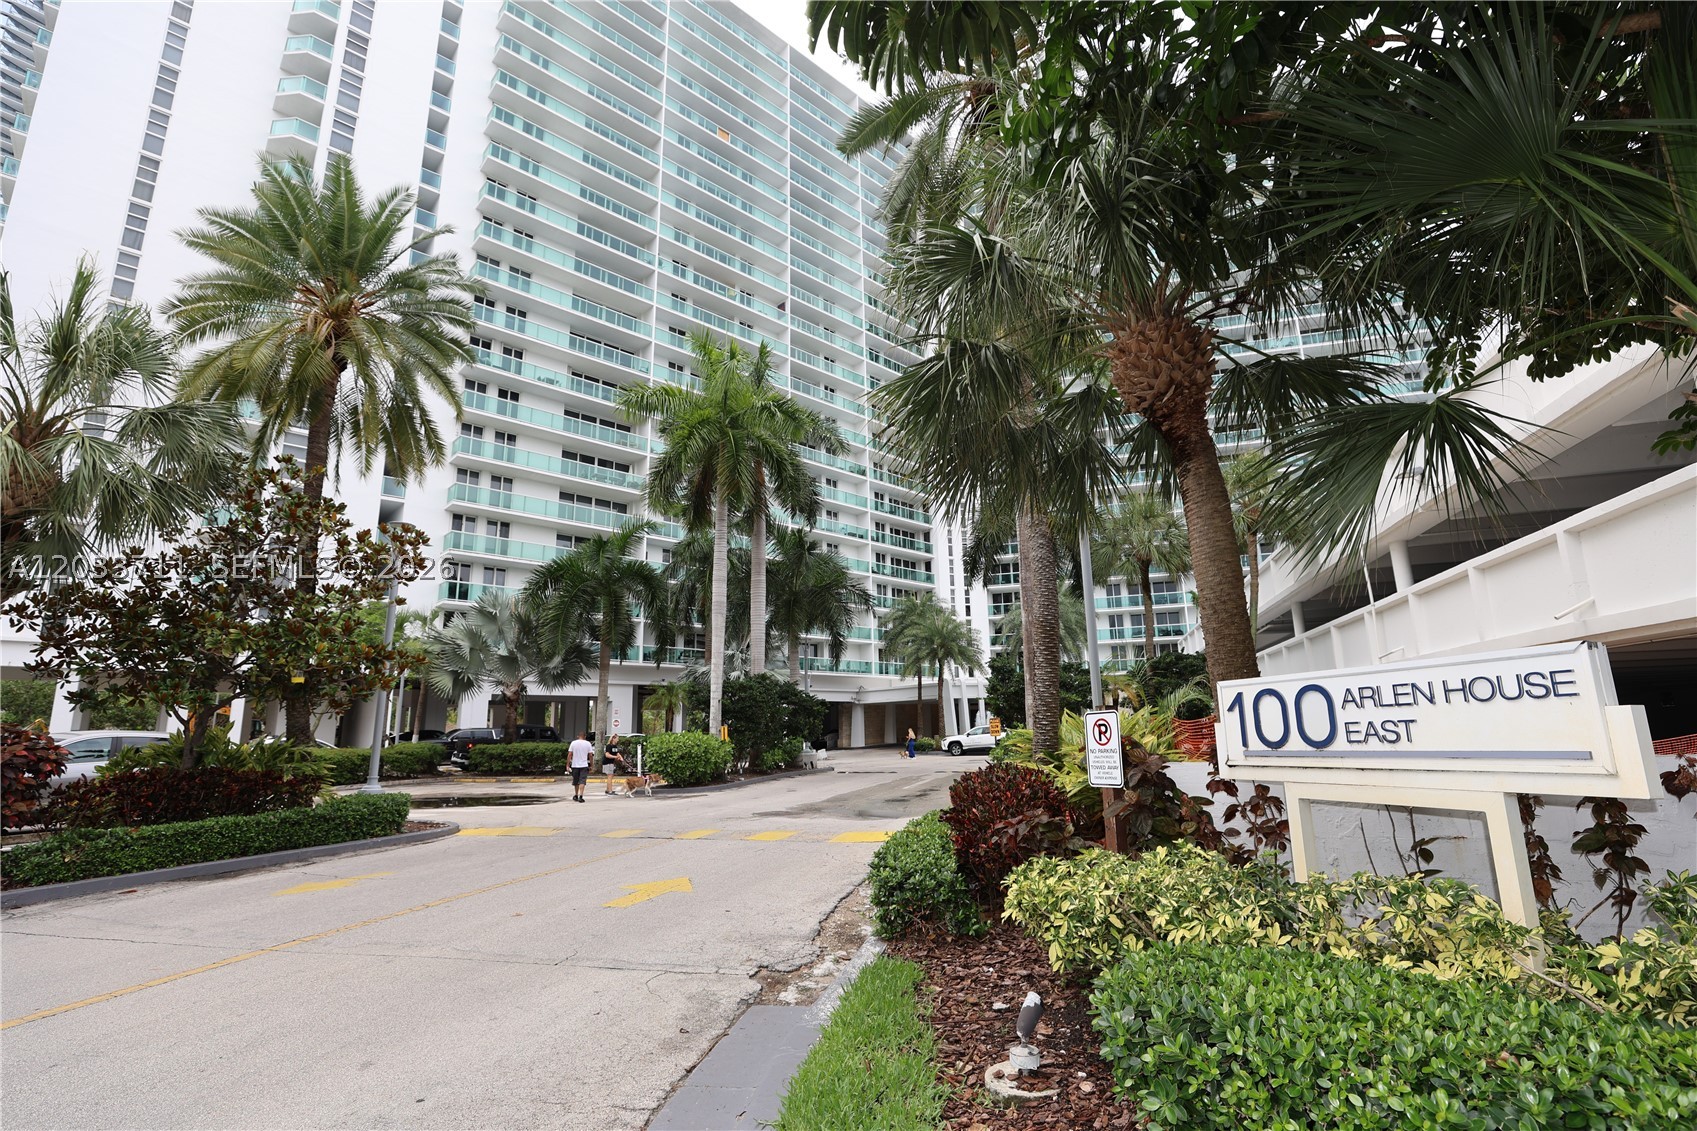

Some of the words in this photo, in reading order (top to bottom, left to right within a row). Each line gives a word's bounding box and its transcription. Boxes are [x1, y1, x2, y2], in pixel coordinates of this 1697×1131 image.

[1227, 684, 1339, 750] 100
[1341, 681, 1436, 711] ARLEN
[1443, 669, 1580, 704] HOUSE
[1344, 718, 1418, 744] EAST
